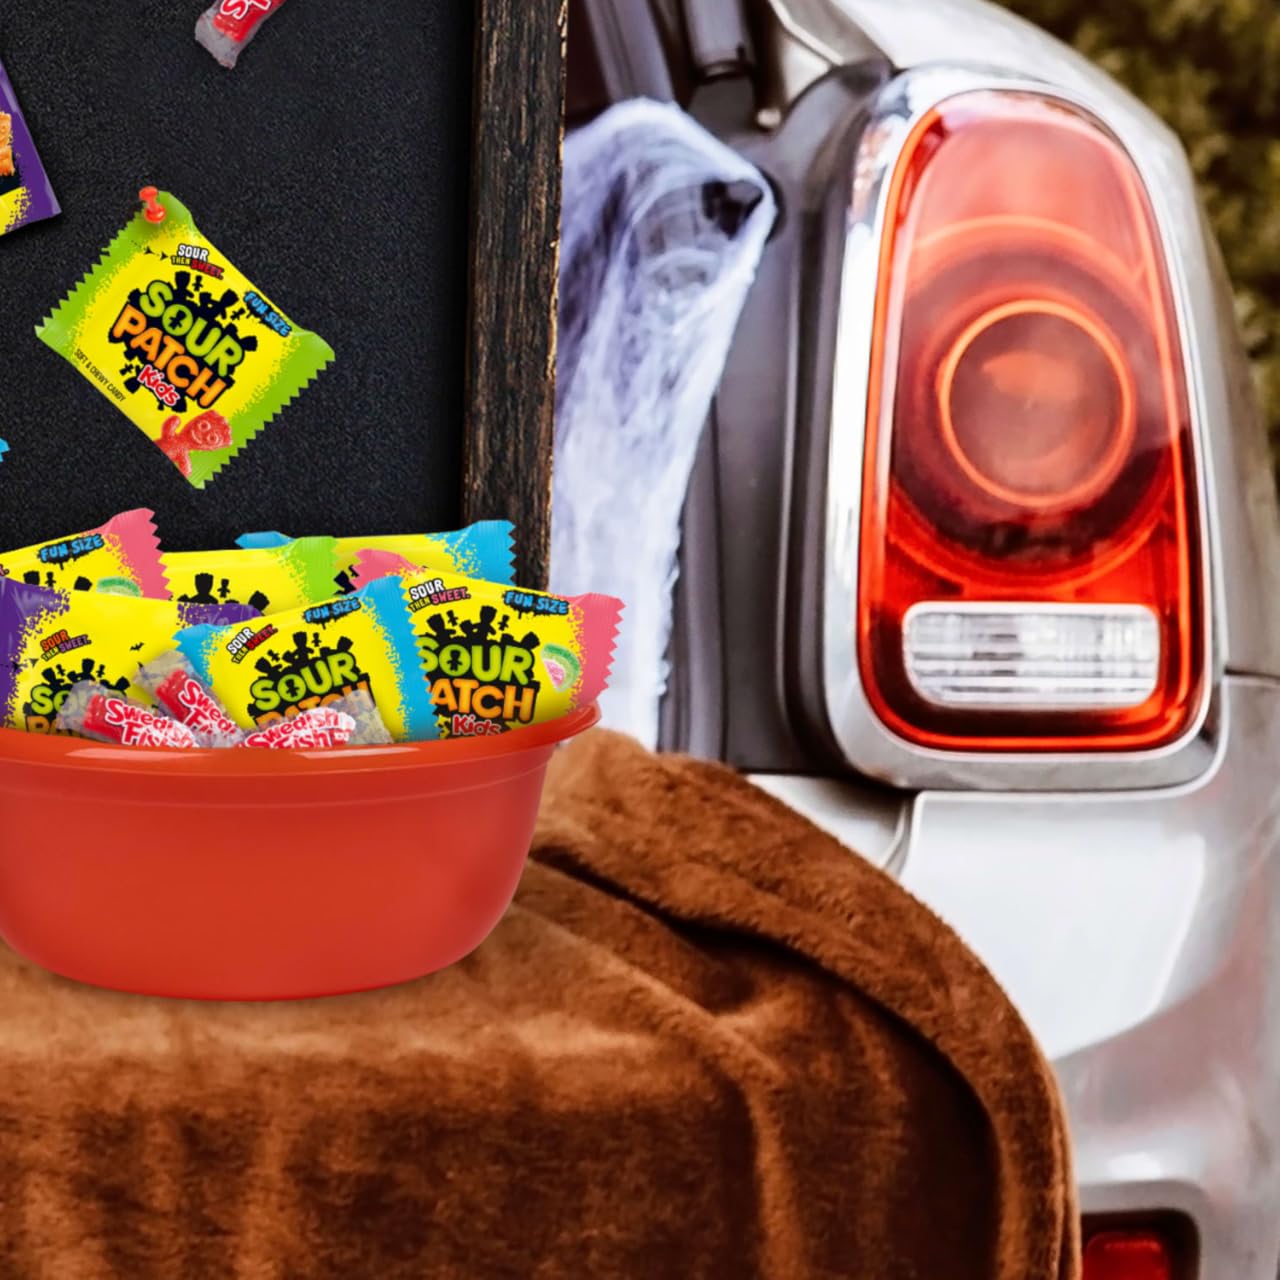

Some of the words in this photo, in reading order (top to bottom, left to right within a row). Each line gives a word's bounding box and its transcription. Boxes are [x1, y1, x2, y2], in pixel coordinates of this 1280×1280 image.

[178, 244, 209, 261] SOUR
[140, 280, 244, 377] SOUR
[244, 292, 269, 314] FUN
[264, 311, 291, 337] SIZE
[112, 304, 226, 407] PATCH
[137, 364, 180, 406] Kids
[40, 545, 68, 562] FUN
[71, 534, 104, 554] SIZE
[410, 578, 445, 601] SOUR
[504, 591, 534, 607] FUN
[535, 597, 569, 615] SIZE
[305, 606, 330, 623] FUN
[332, 597, 361, 615] SIZE
[409, 597, 431, 612] THEN
[40, 629, 70, 652] SOUR
[227, 627, 254, 655] SOUR
[416, 636, 533, 685] SOUR
[251, 652, 358, 710] SOUR
[427, 677, 535, 721] ATCH
